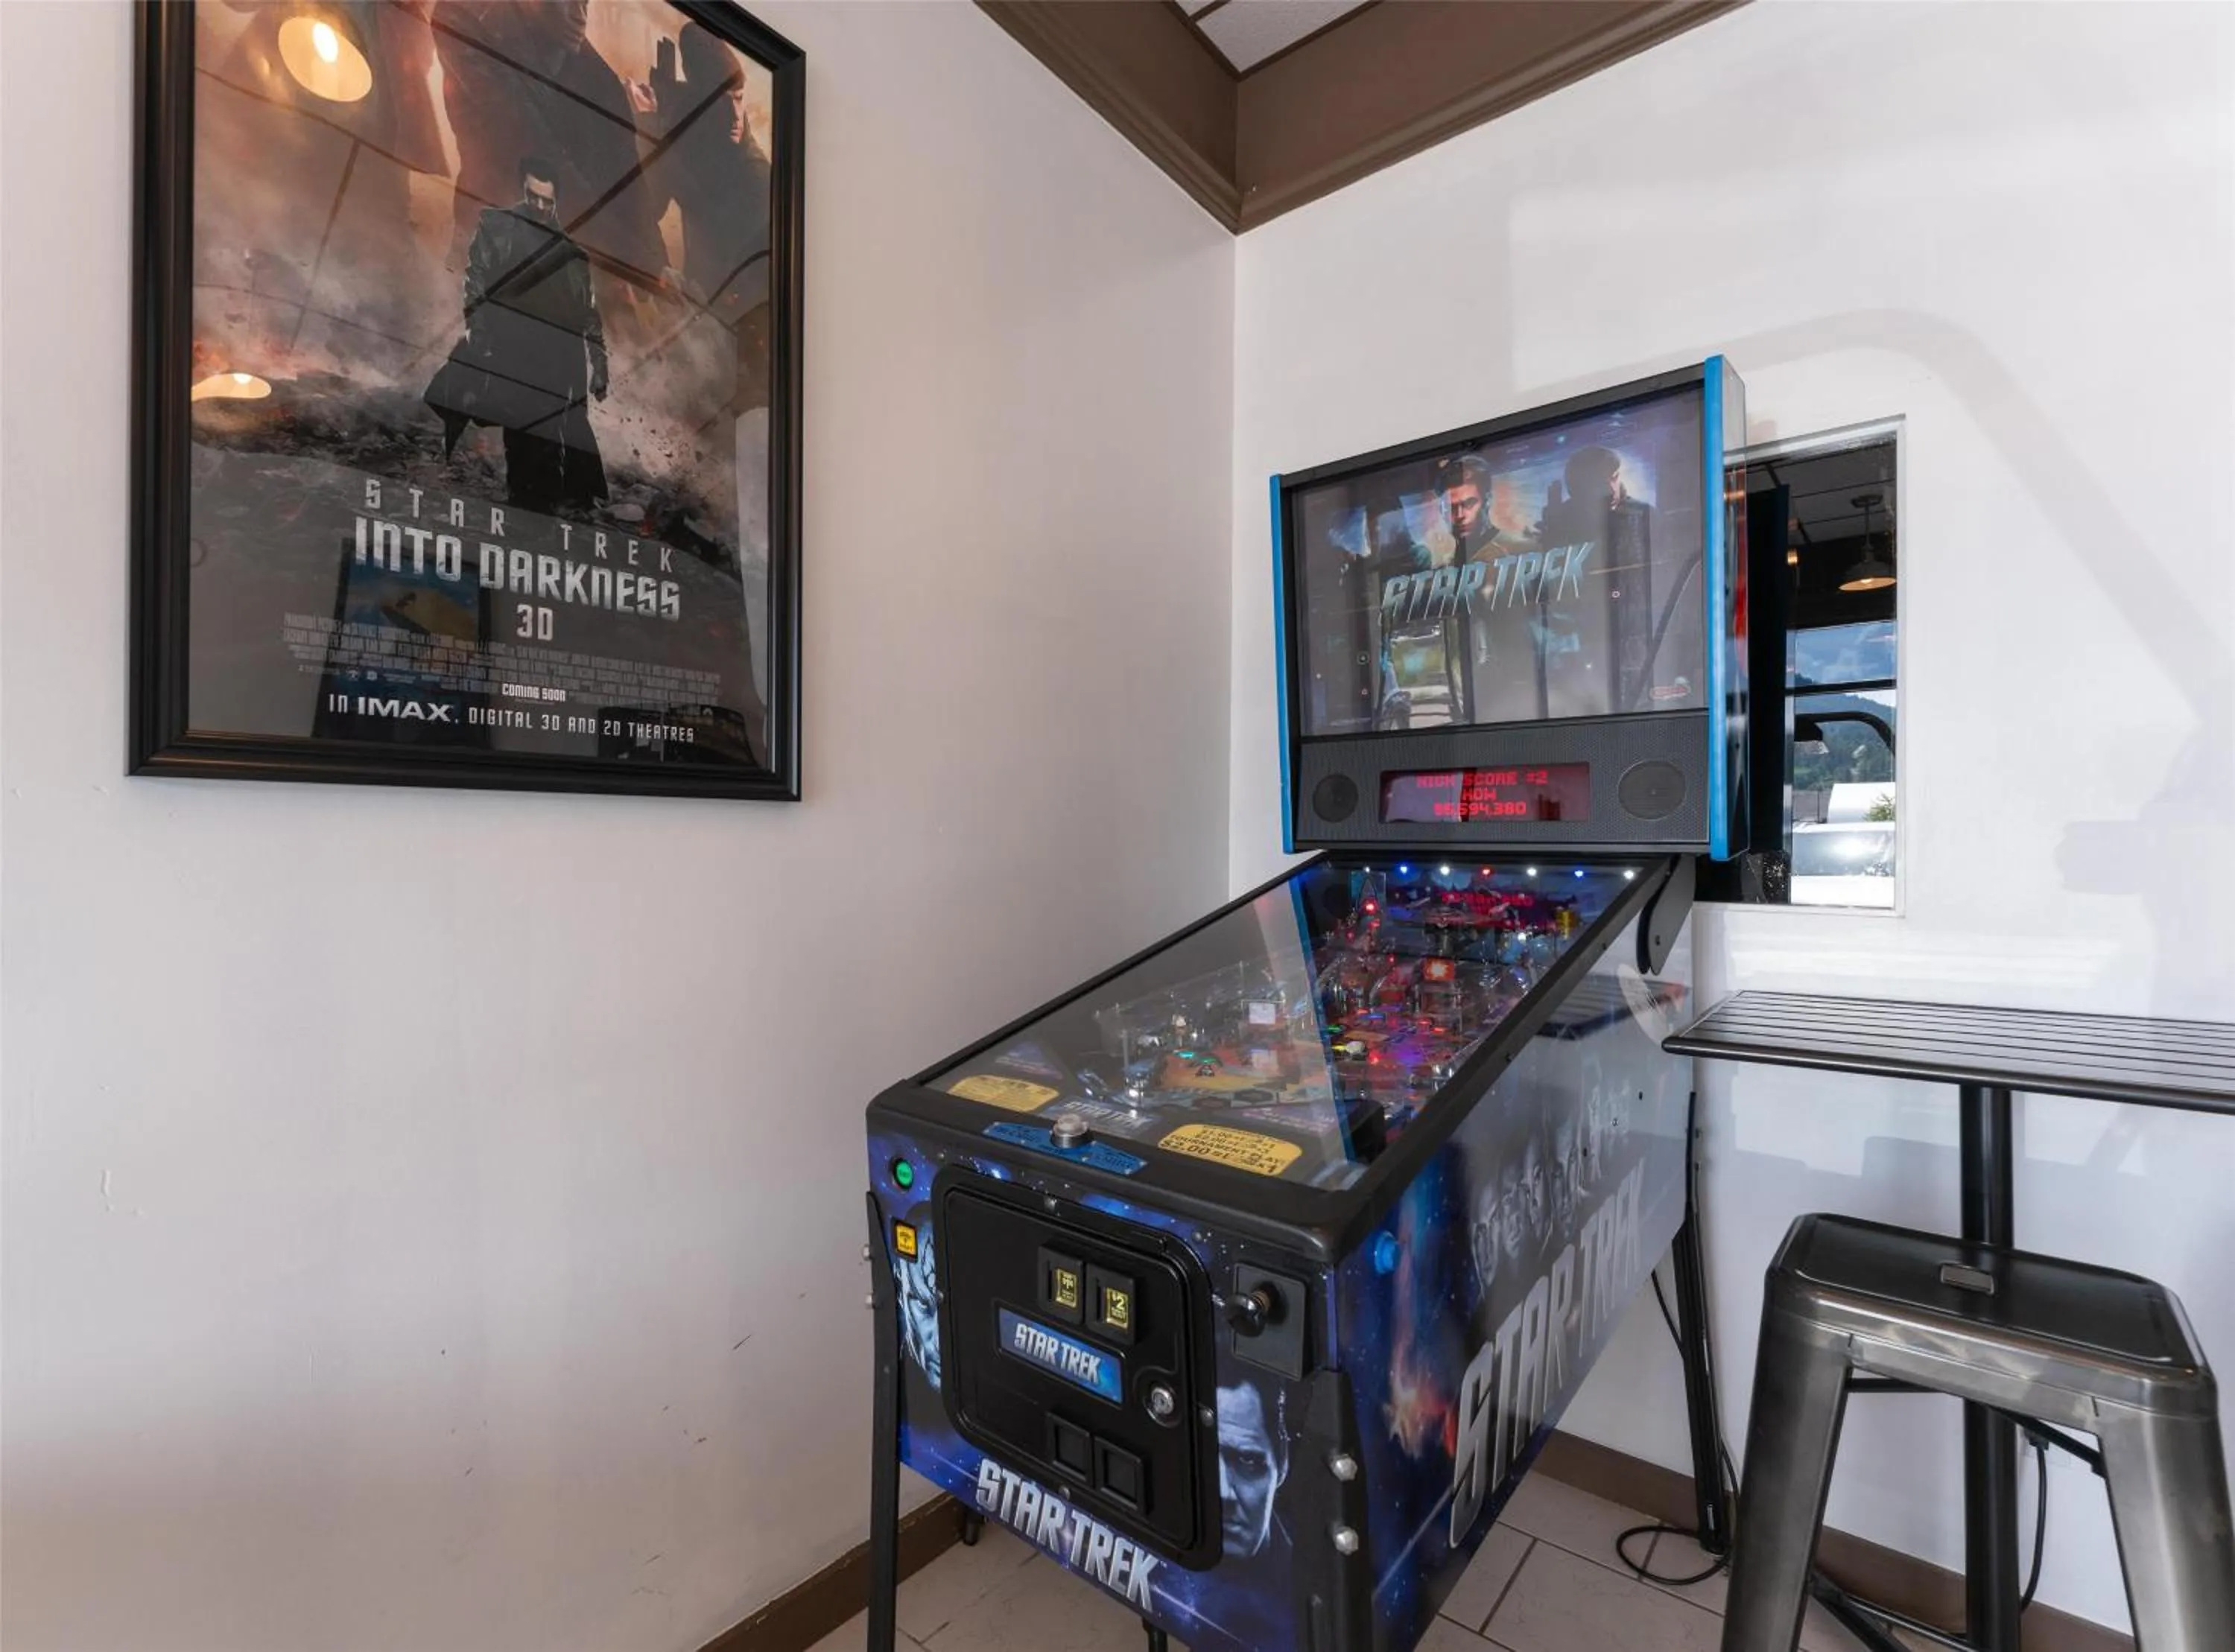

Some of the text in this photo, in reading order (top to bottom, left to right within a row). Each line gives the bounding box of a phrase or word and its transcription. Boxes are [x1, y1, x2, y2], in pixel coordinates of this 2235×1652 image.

[365, 479, 673, 573] STAR TREK
[355, 516, 681, 621] INTO DARKNESS
[1378, 561, 1488, 624] STAR
[516, 604, 554, 641] 3D
[329, 693, 348, 714] IN
[469, 707, 533, 729] DIGITAL
[542, 714, 559, 731] 3D
[568, 716, 596, 734] AND
[604, 719, 621, 736] 2D
[628, 722, 694, 743] THEATRES
[502, 682, 566, 702] COMING SOON
[1416, 775, 1456, 788] HIGH
[1463, 771, 1518, 787] SCORE
[1014, 1323, 1101, 1385] STAR TREK
[1450, 1242, 1575, 1548] STAR
[976, 1458, 1158, 1613] STAR TREK
